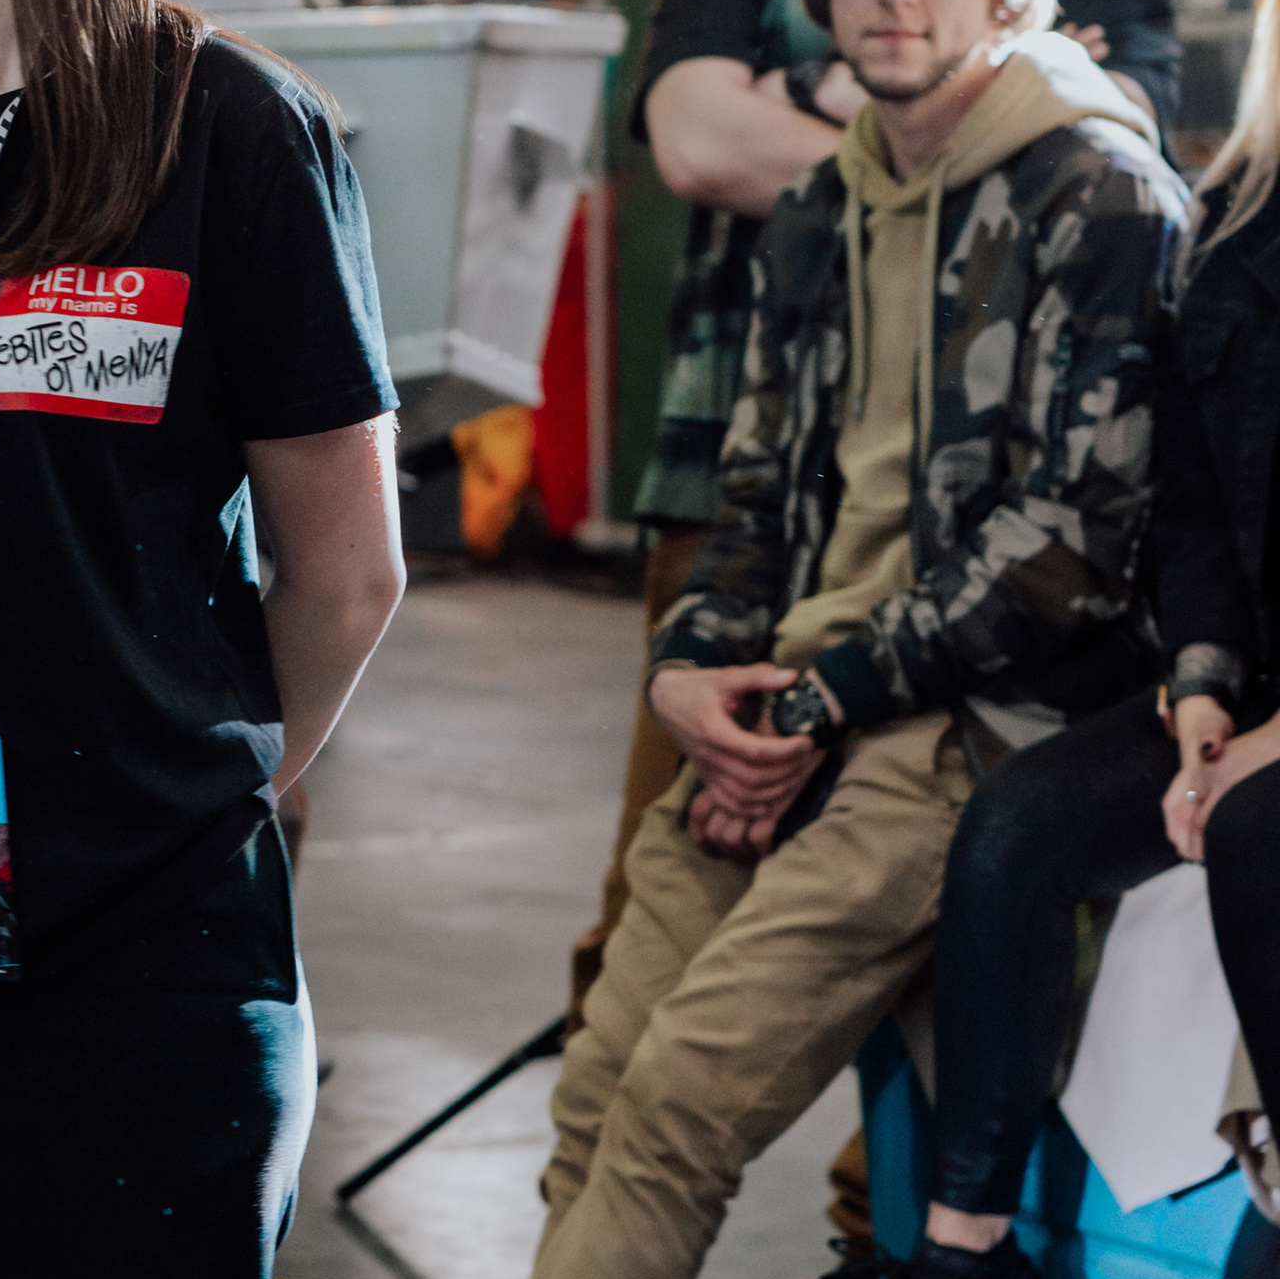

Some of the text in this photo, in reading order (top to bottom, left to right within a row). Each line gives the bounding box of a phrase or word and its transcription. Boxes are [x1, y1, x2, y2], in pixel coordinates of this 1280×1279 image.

[28, 267, 145, 298] HELLO
[28, 297, 138, 315] my name is
[46, 355, 77, 392] OT
